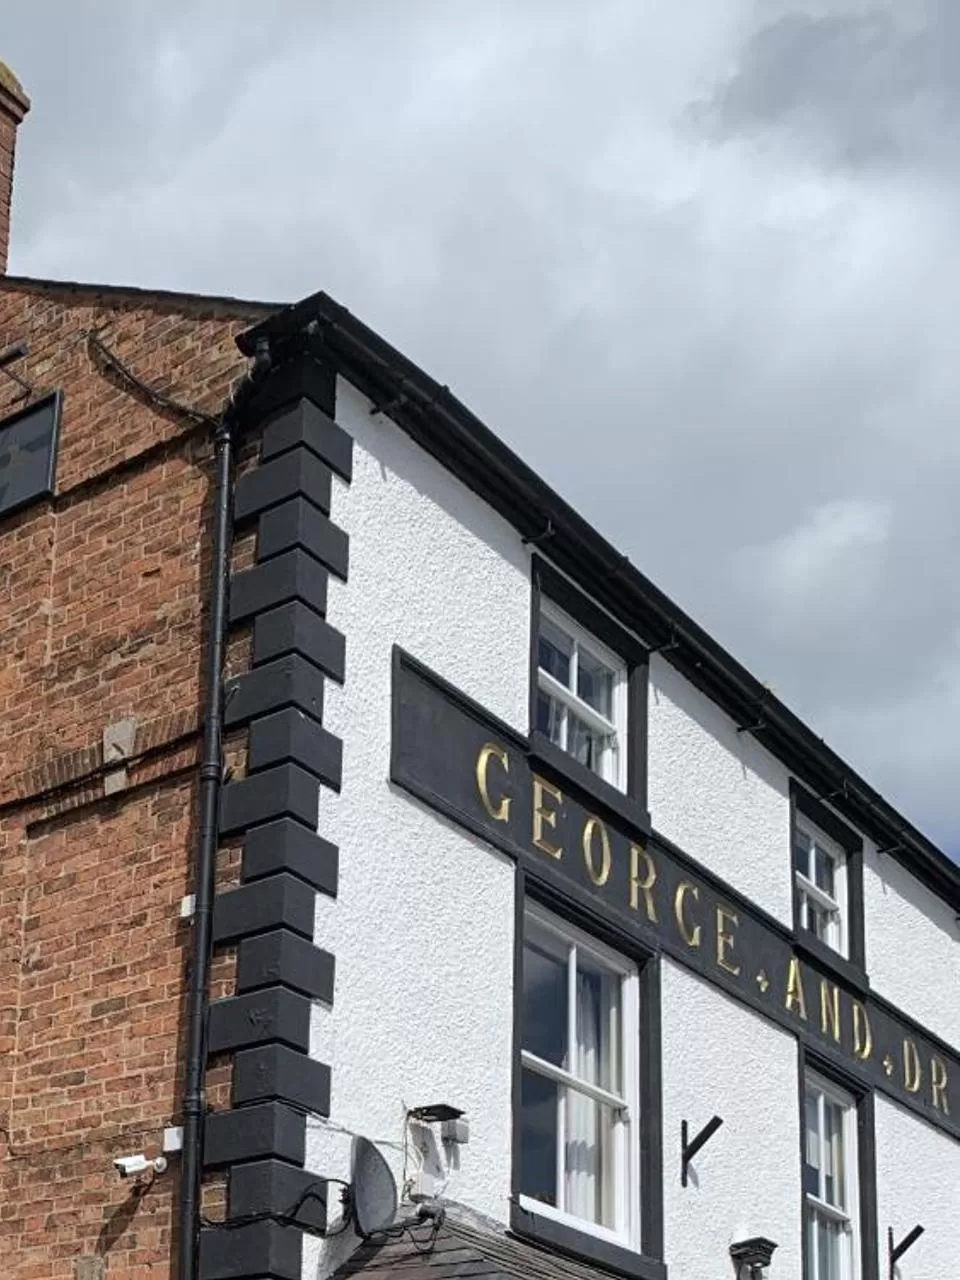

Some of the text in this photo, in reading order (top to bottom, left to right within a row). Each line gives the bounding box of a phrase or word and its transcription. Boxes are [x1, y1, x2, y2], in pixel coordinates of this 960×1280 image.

[475, 743, 950, 1115] GEORGE AND DR
